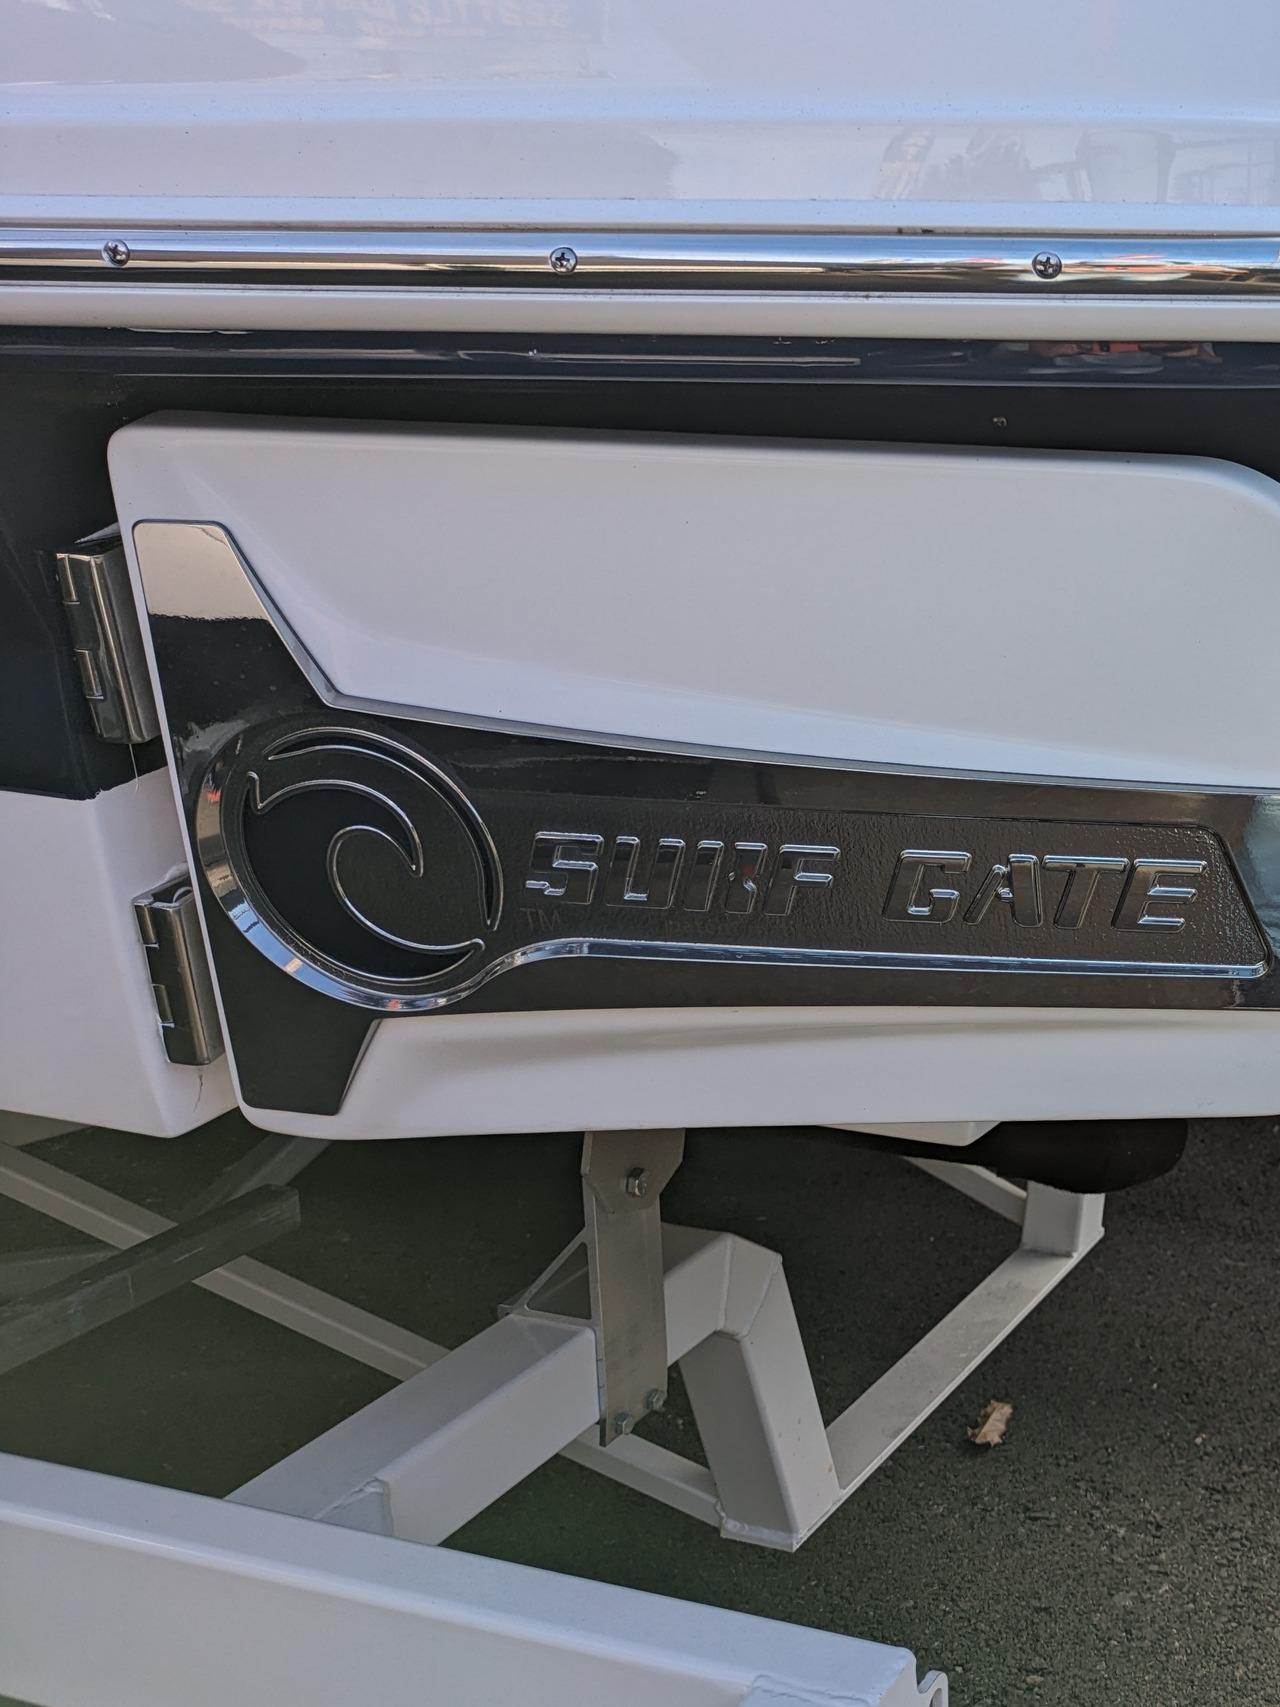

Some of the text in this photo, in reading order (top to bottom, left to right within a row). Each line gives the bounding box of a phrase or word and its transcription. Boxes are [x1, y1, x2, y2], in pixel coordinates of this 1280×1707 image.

[524, 830, 1207, 932] SURF GATE
[520, 907, 560, 930] TM
